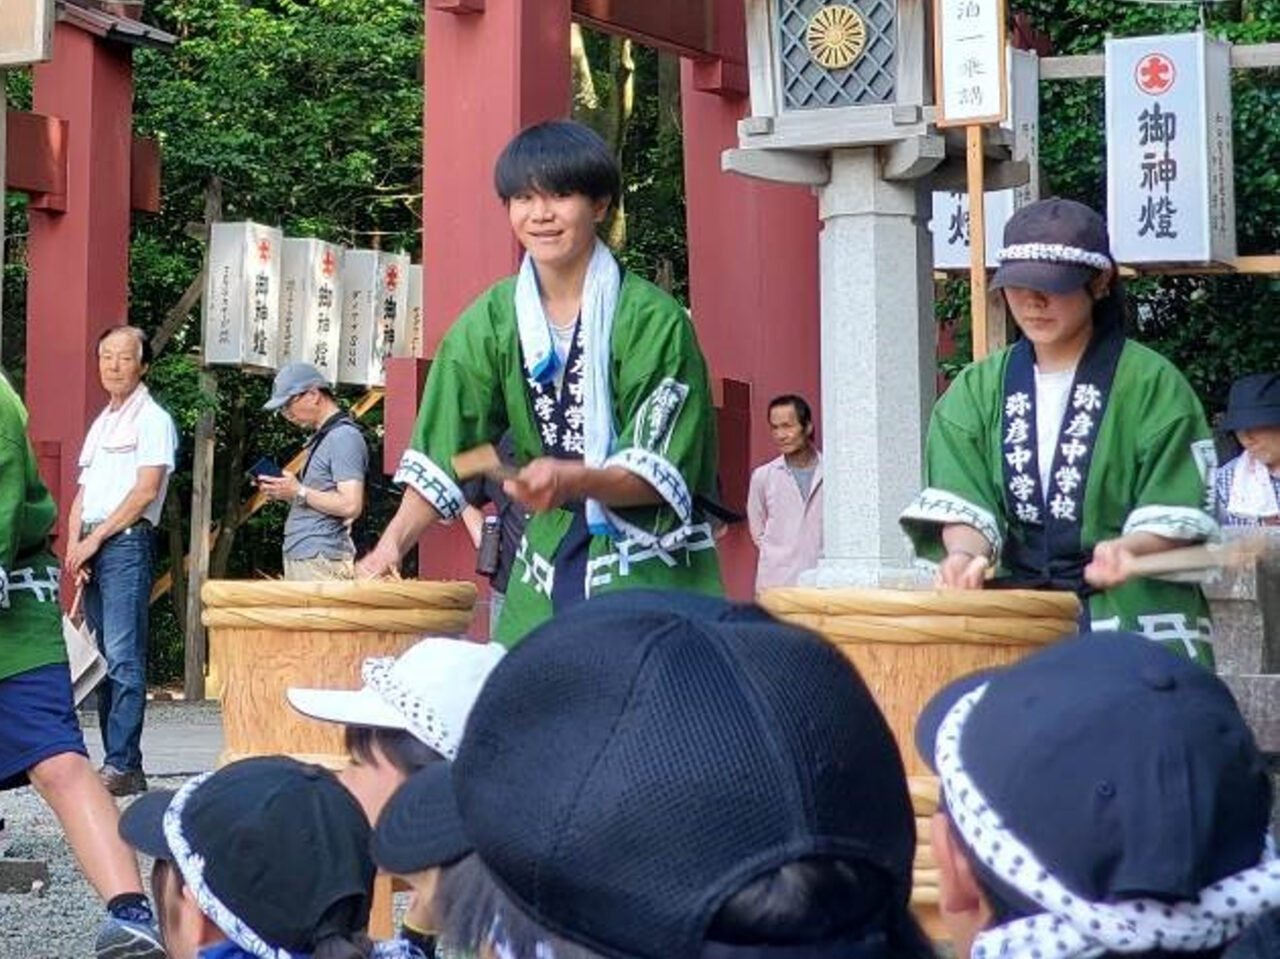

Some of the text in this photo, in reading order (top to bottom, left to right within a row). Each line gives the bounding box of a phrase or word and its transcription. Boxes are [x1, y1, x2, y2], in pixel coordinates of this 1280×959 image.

[1137, 102, 1177, 240] 御神燈
[1004, 392, 1043, 524] 弥彦中学校
[1050, 383, 1102, 522] 弥彦中学校
